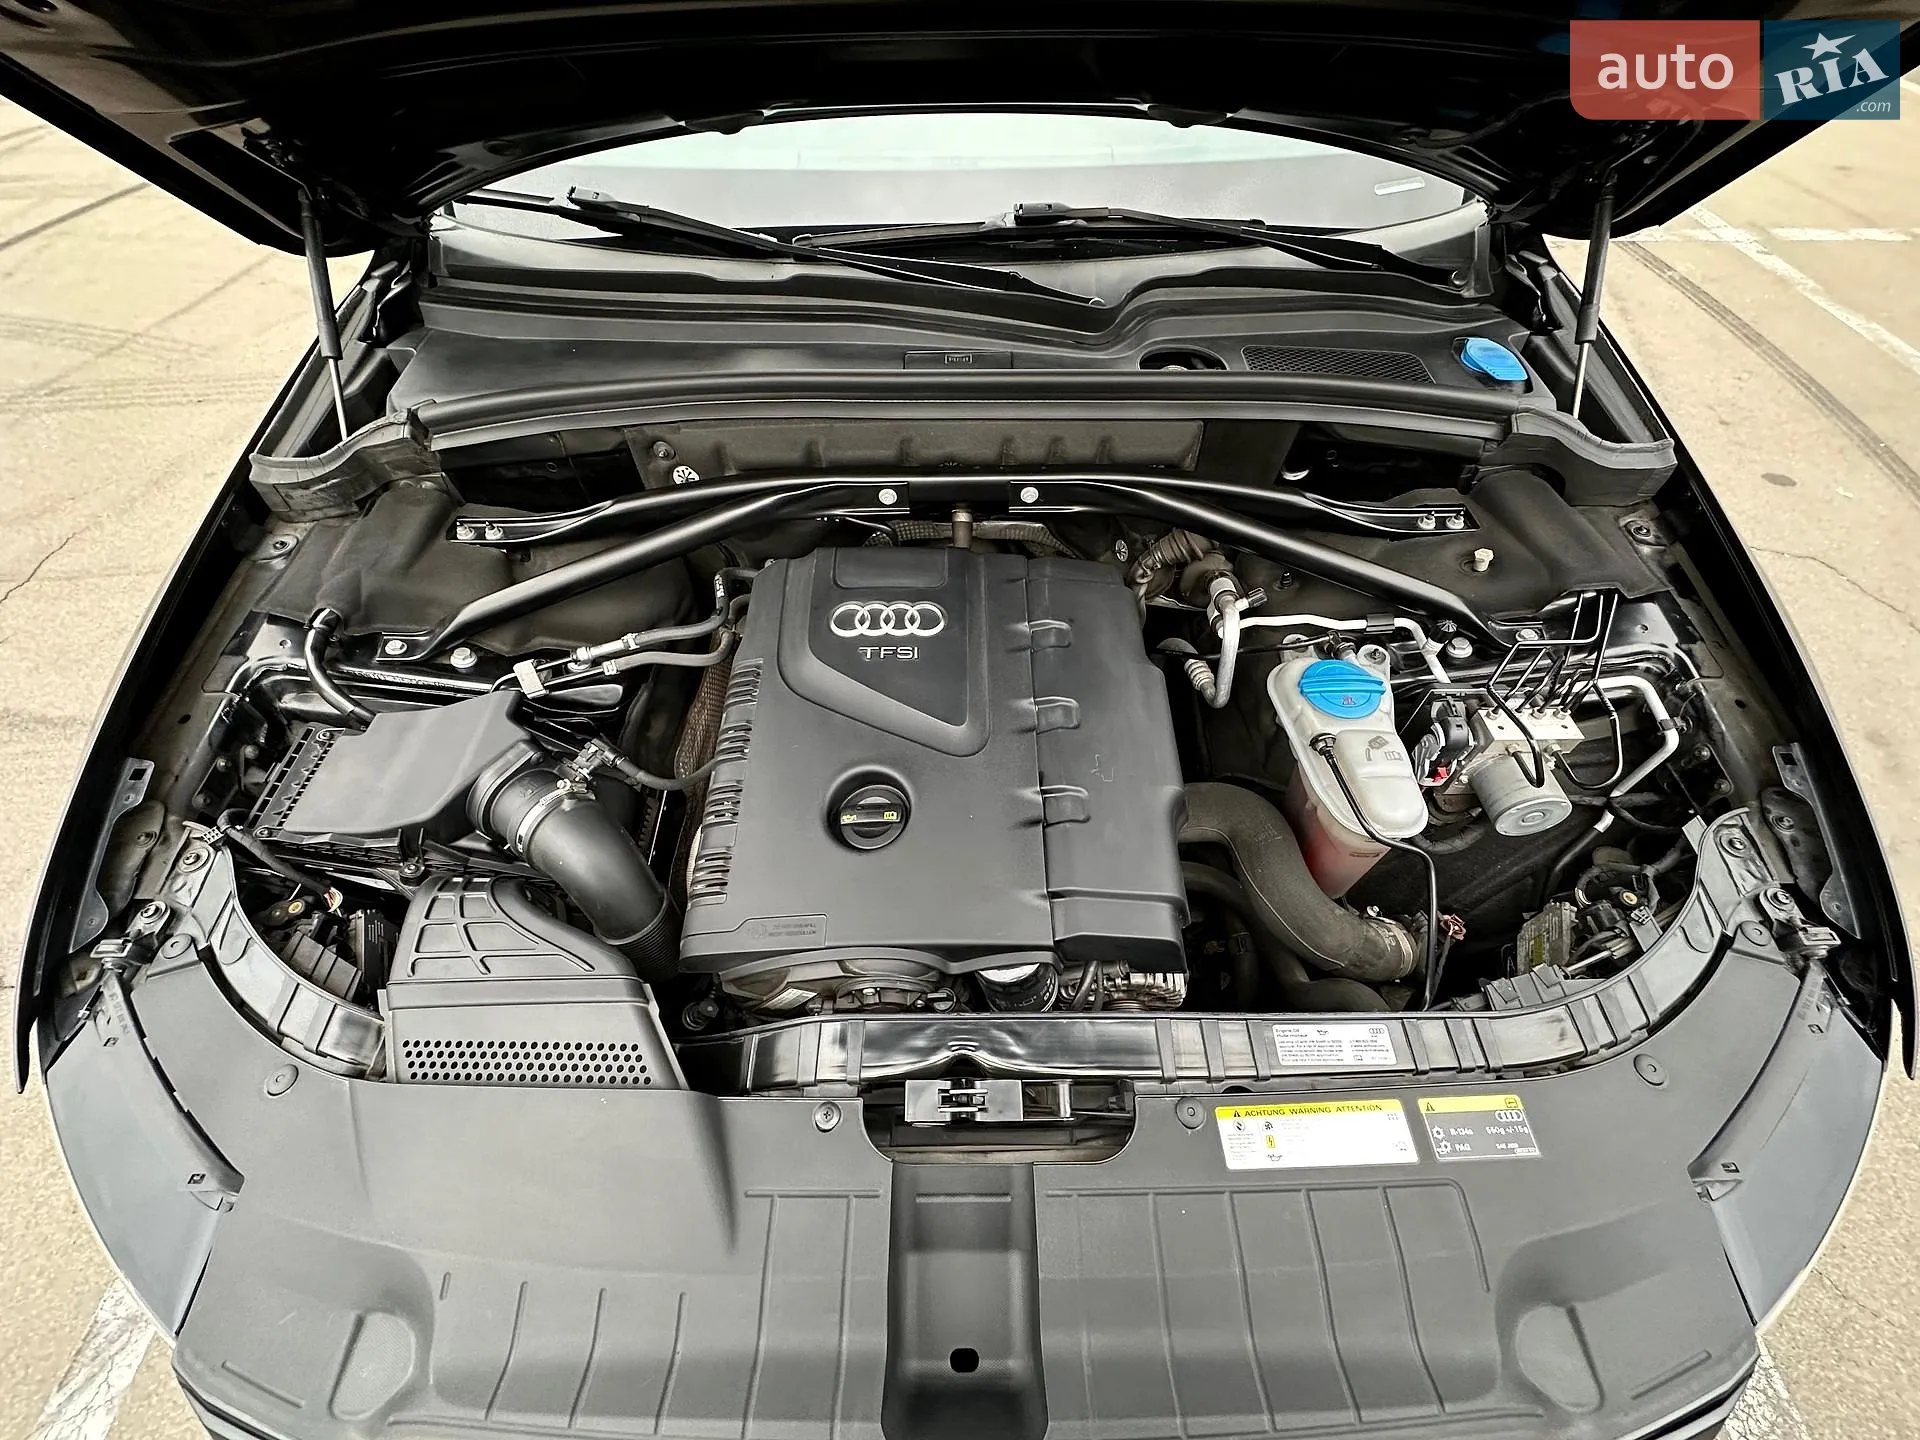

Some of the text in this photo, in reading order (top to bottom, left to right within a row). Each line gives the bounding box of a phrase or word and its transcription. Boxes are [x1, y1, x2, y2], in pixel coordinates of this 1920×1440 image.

[858, 646, 919, 660] TFSI
[1244, 1104, 1383, 1118] ACHTUNG WARNING ATTENTION
